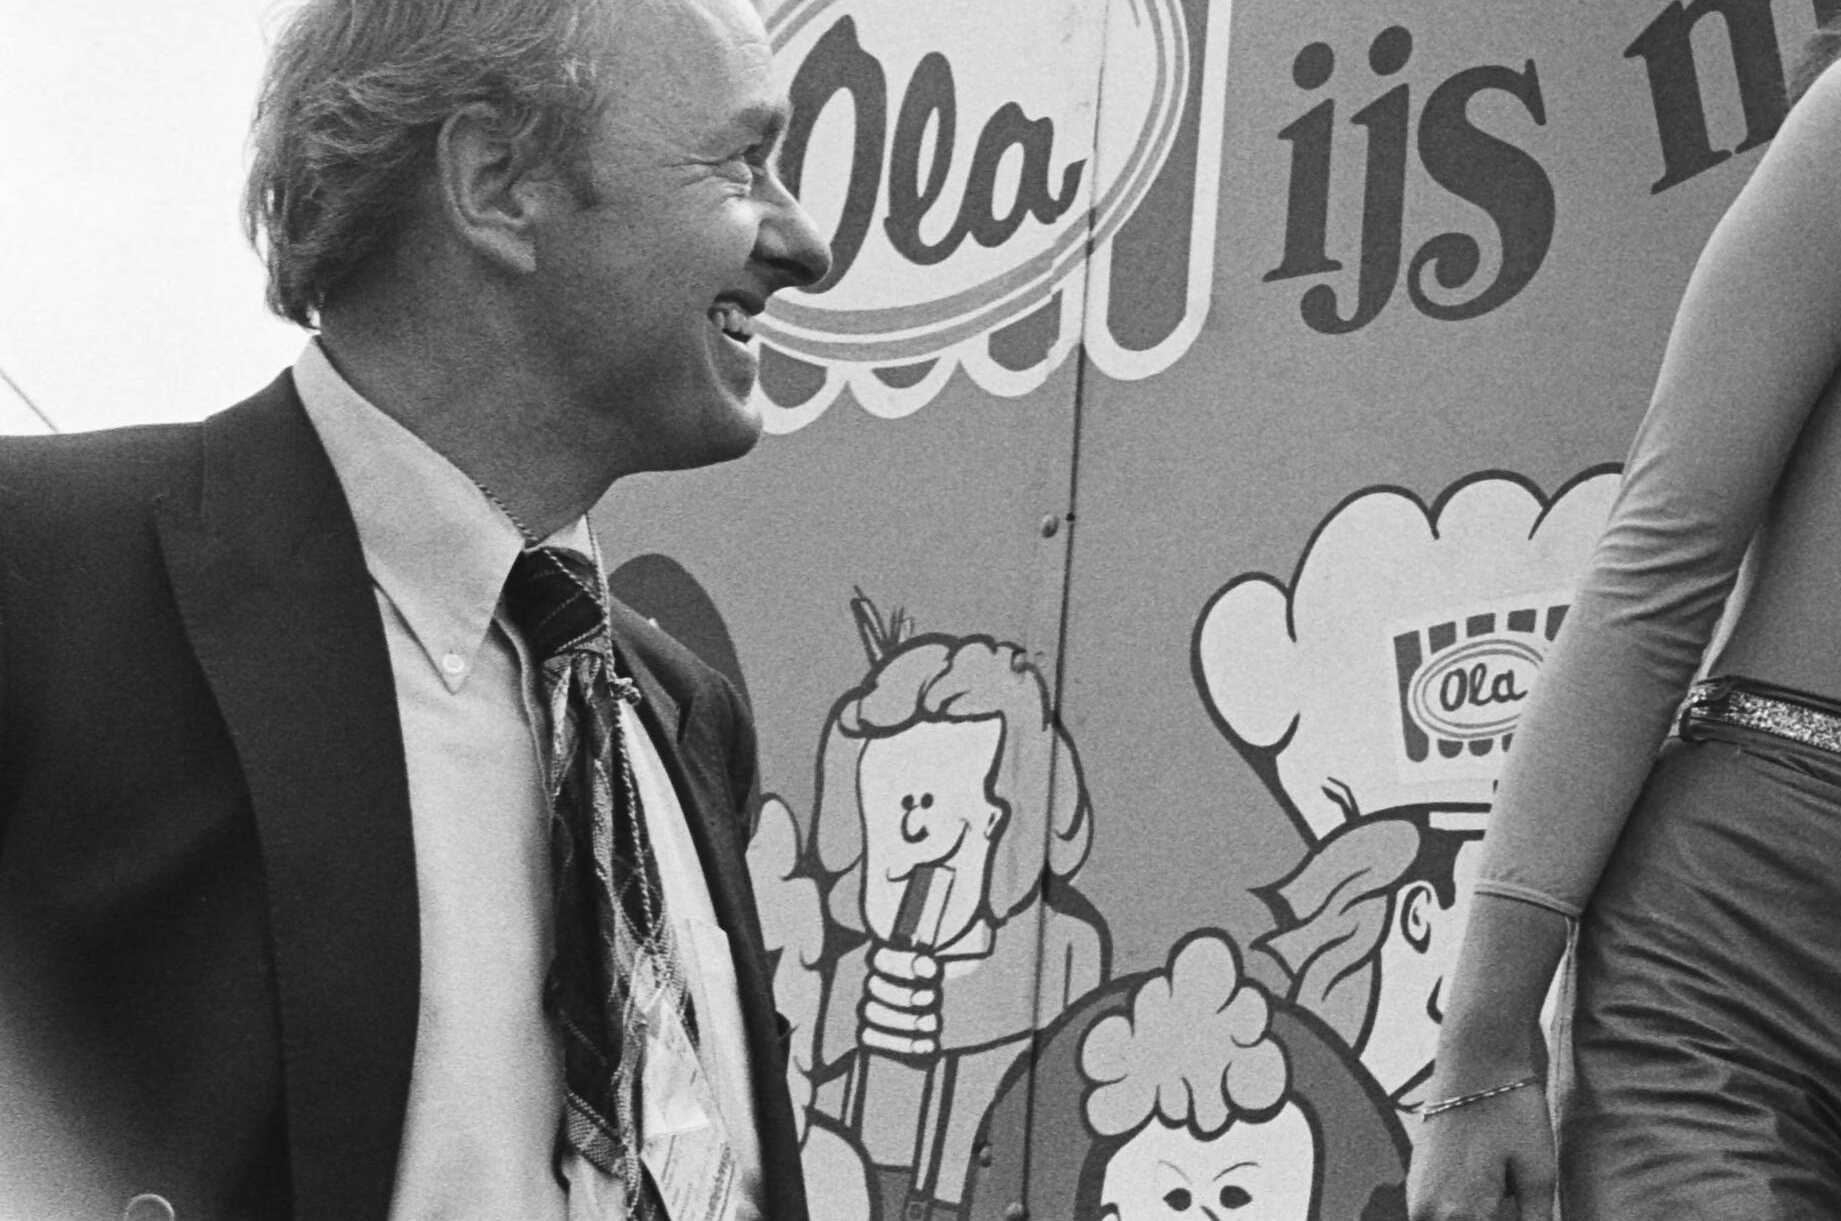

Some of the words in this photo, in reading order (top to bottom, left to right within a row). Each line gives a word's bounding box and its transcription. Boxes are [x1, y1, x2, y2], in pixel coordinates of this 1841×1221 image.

[774, 13, 1088, 295] Ola
[1262, 25, 1557, 335] ijs
[1439, 662, 1529, 713] Ola
